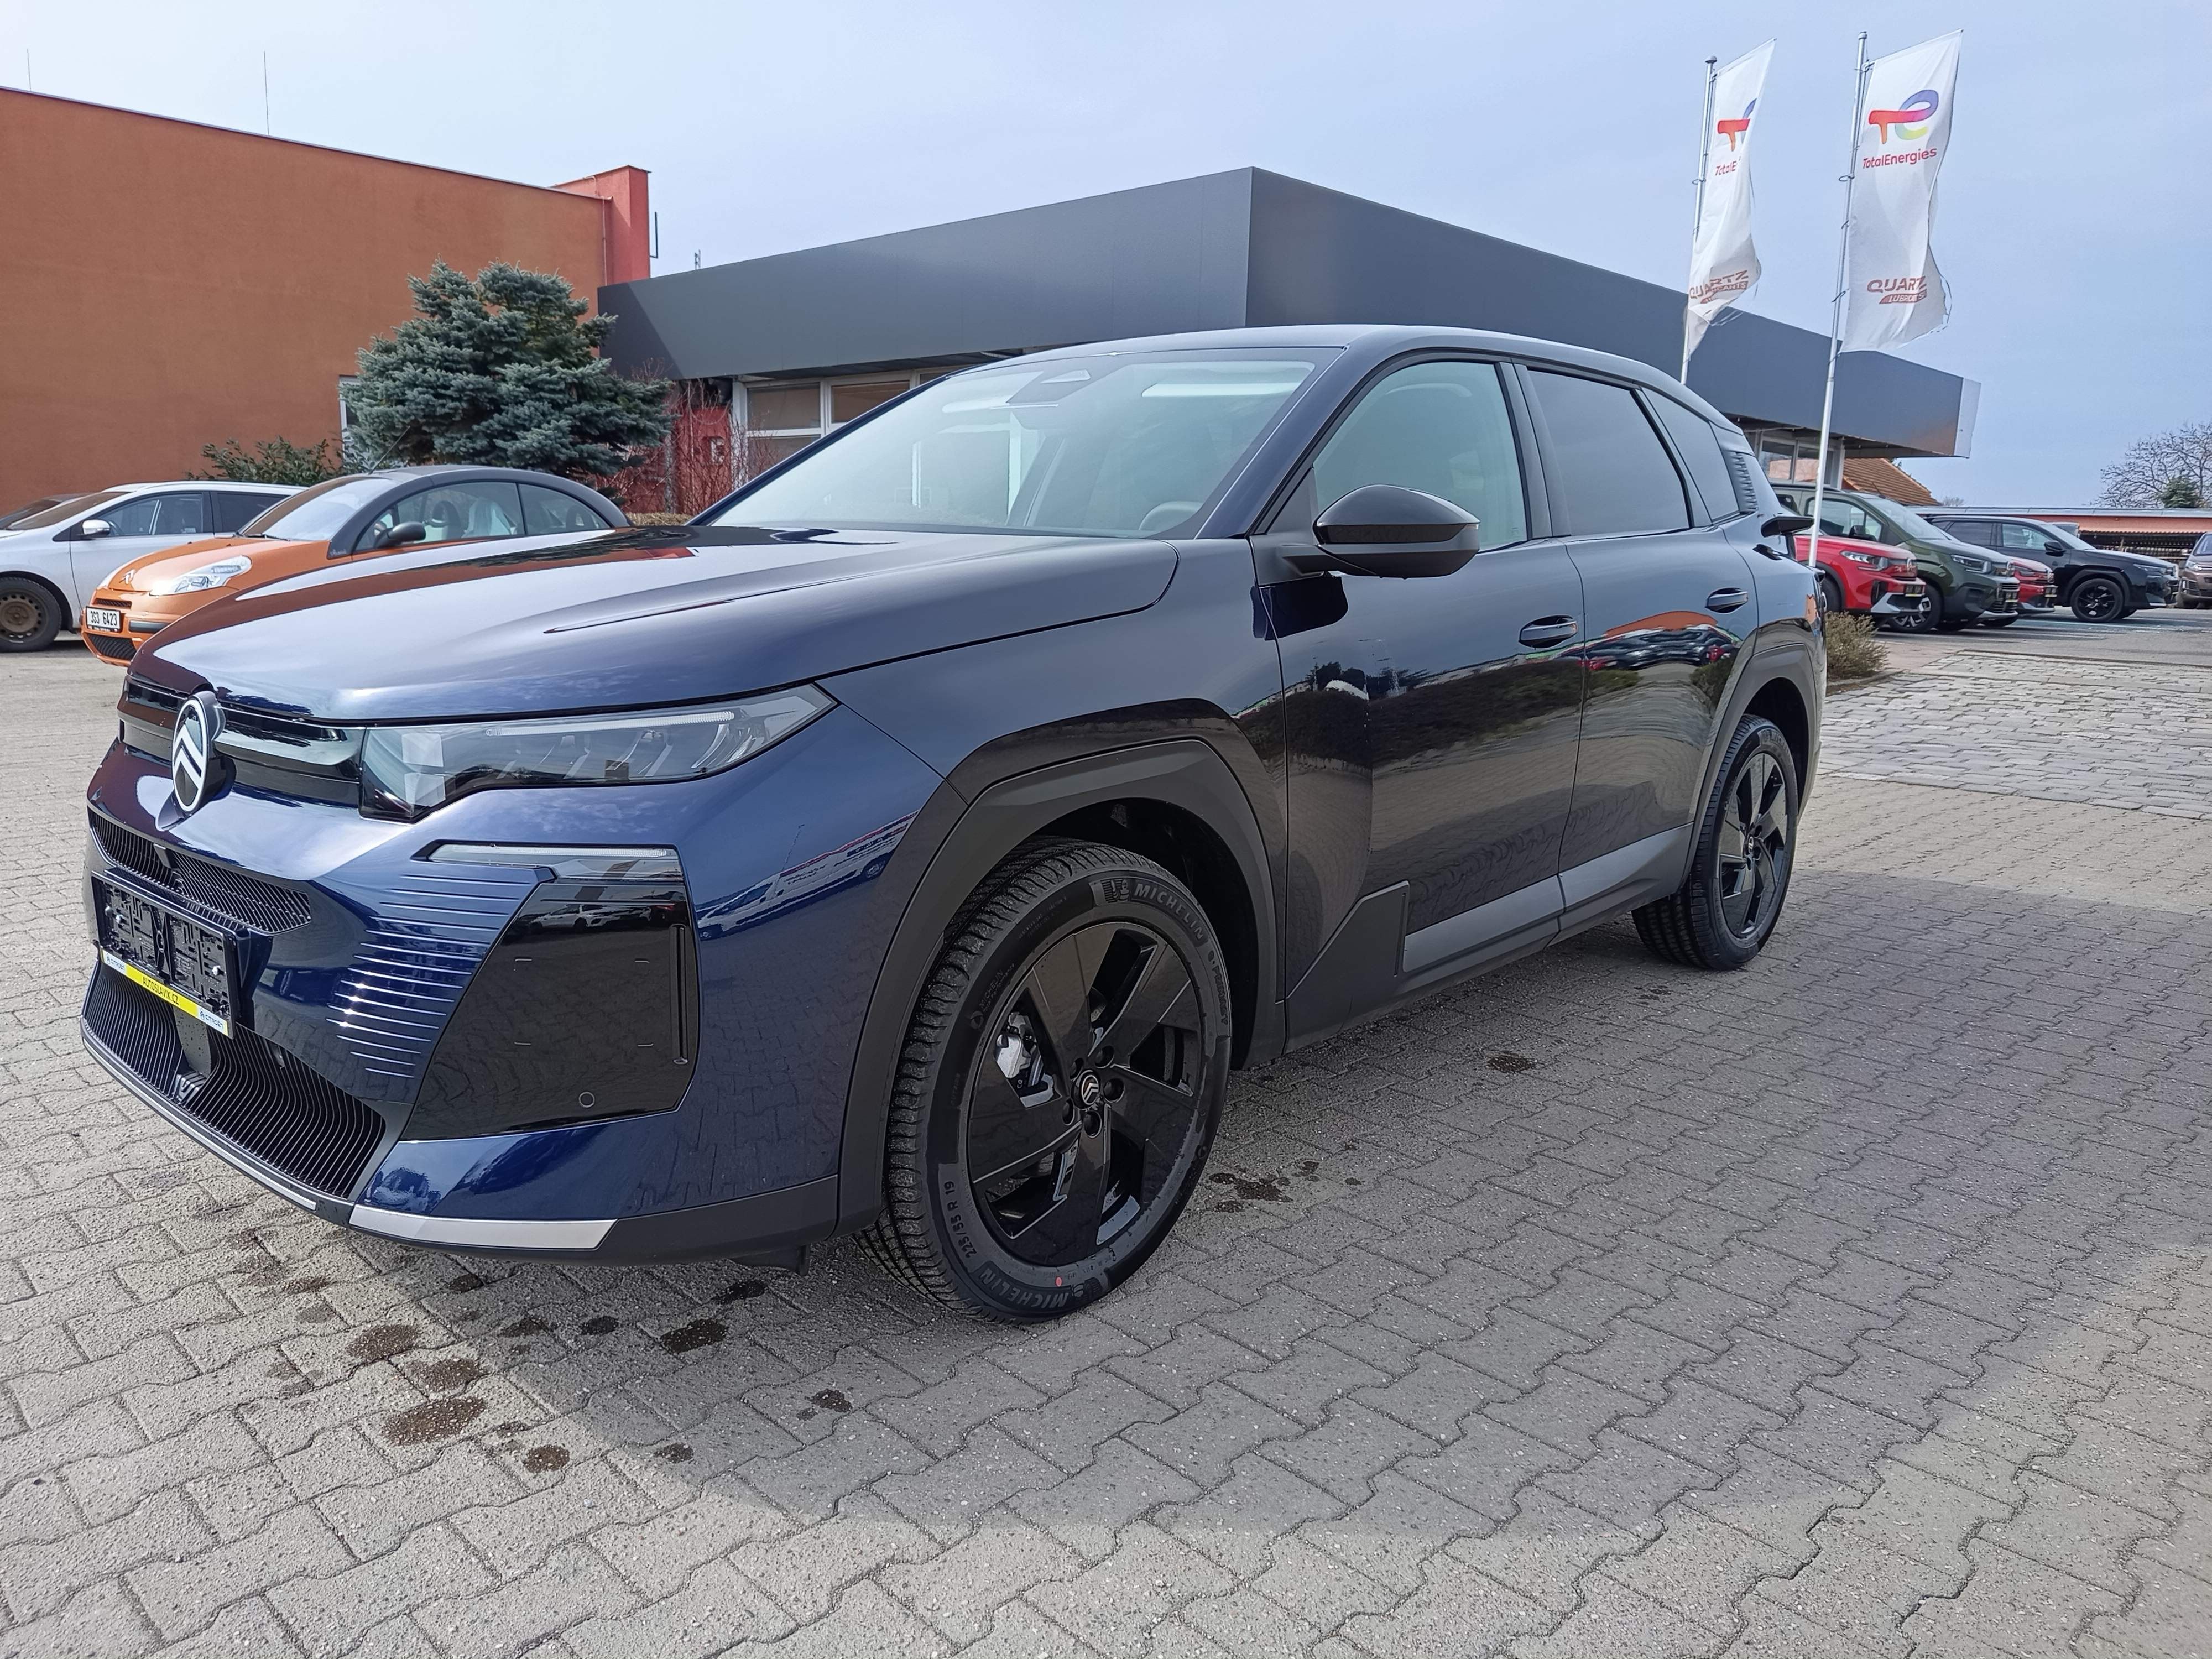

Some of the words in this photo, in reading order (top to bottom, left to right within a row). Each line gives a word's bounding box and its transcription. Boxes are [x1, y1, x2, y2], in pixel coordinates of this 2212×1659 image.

[1715, 156, 1741, 176] TotalE
[1863, 148, 1937, 169] TotalEnergies
[102, 612, 117, 626] 6423
[1134, 883, 1203, 940] MICHELIN
[943, 1181, 956, 1195] 19
[947, 1200, 958, 1212] R
[950, 1214, 977, 1258] 225/55
[979, 1267, 1070, 1308] MICHELIN
